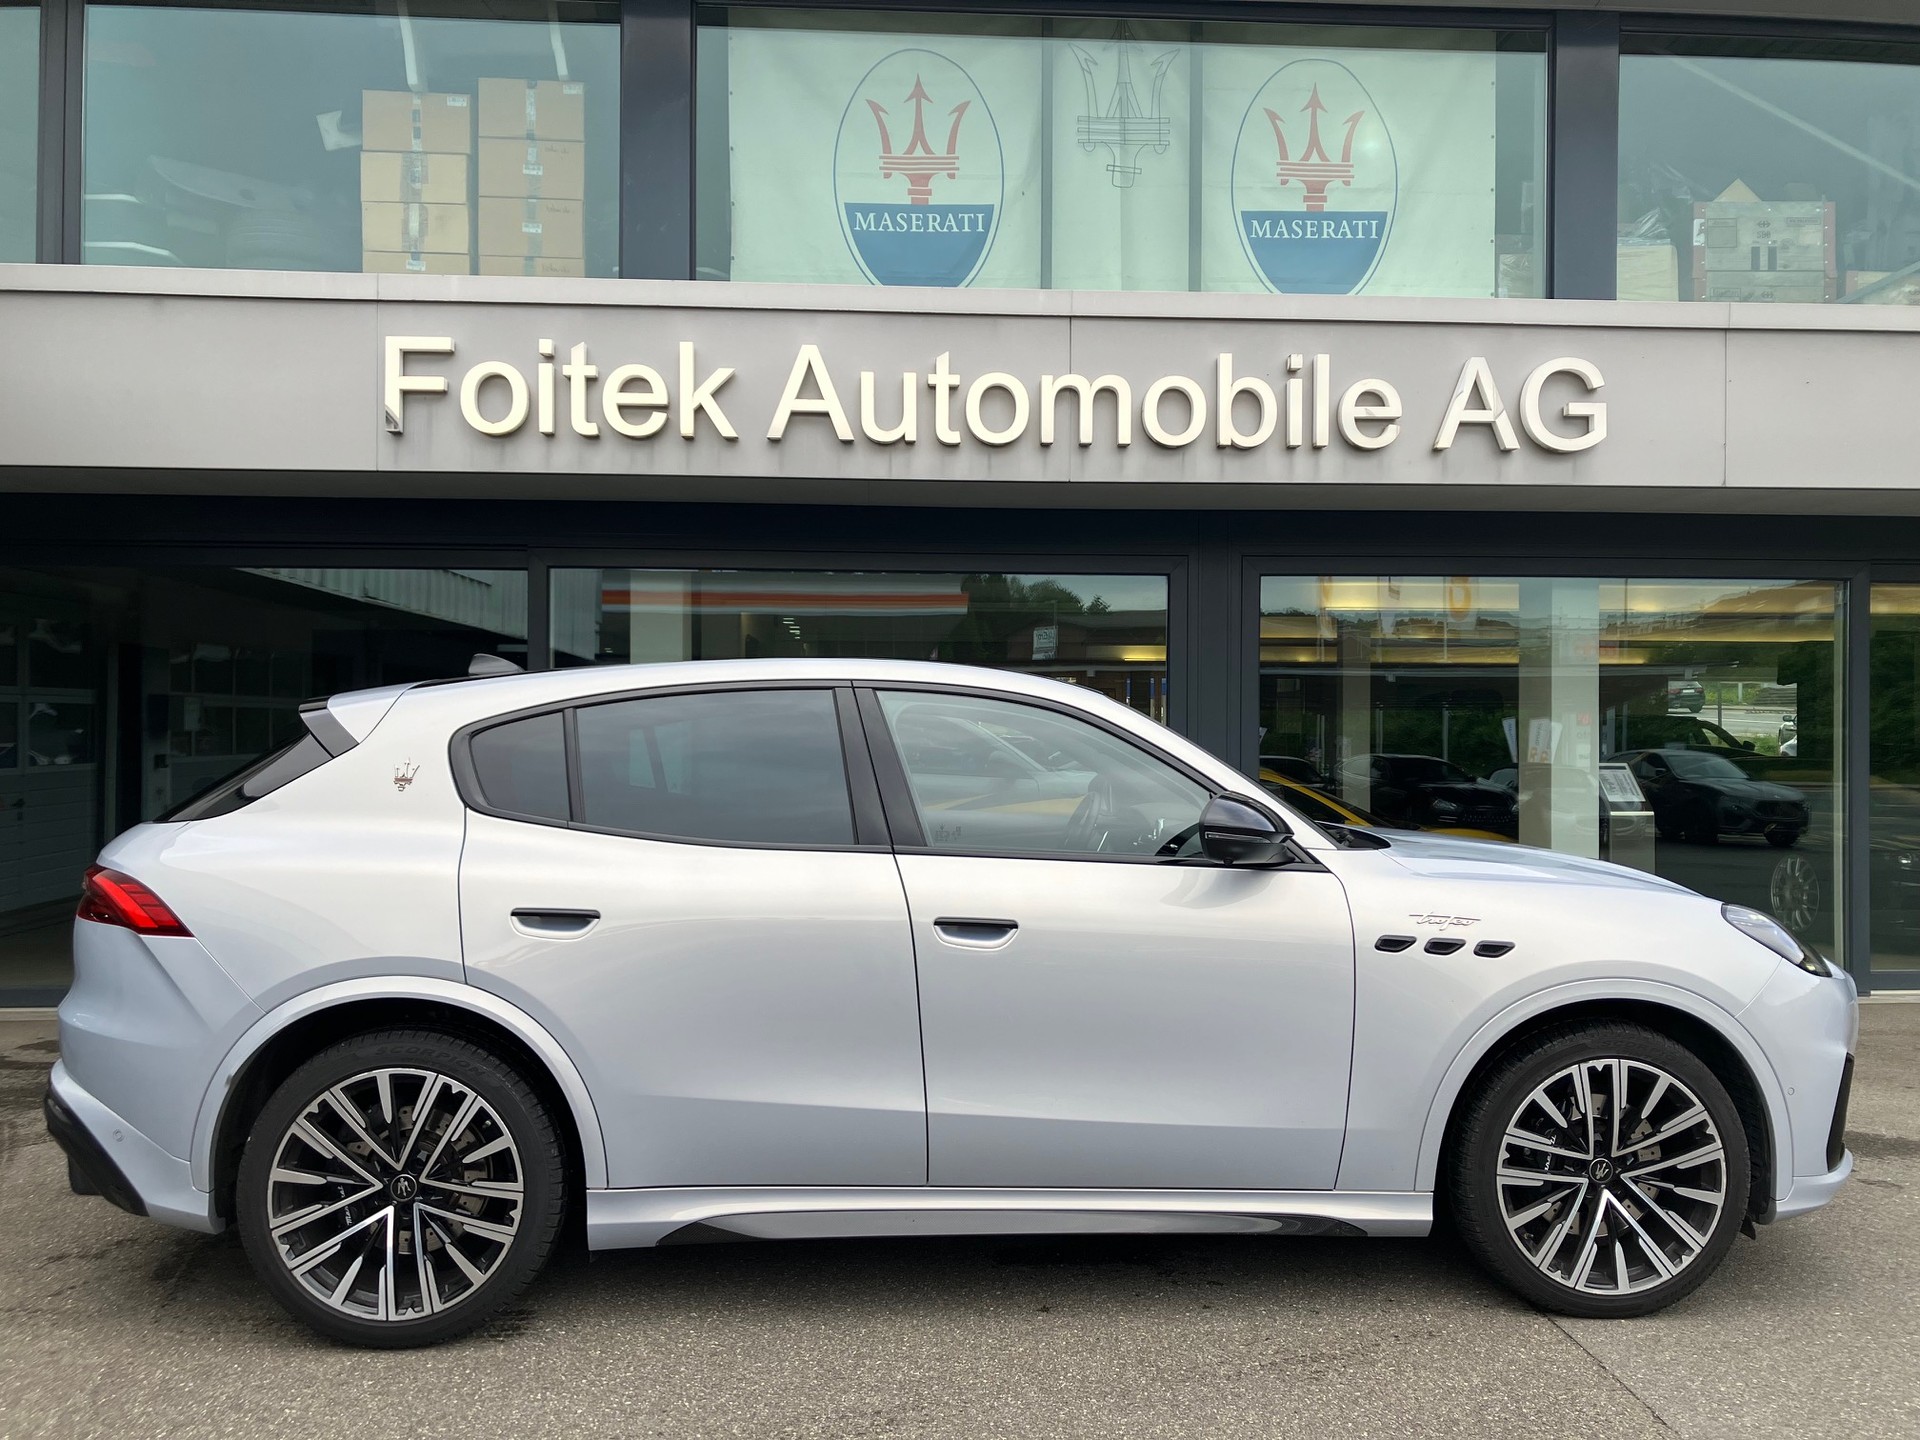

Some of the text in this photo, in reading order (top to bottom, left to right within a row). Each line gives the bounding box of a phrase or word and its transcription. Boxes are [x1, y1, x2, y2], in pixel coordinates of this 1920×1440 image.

[853, 211, 985, 233] MASERATI
[1250, 219, 1379, 239] MASERATI
[384, 335, 1608, 455] Foitek Automobile AG
